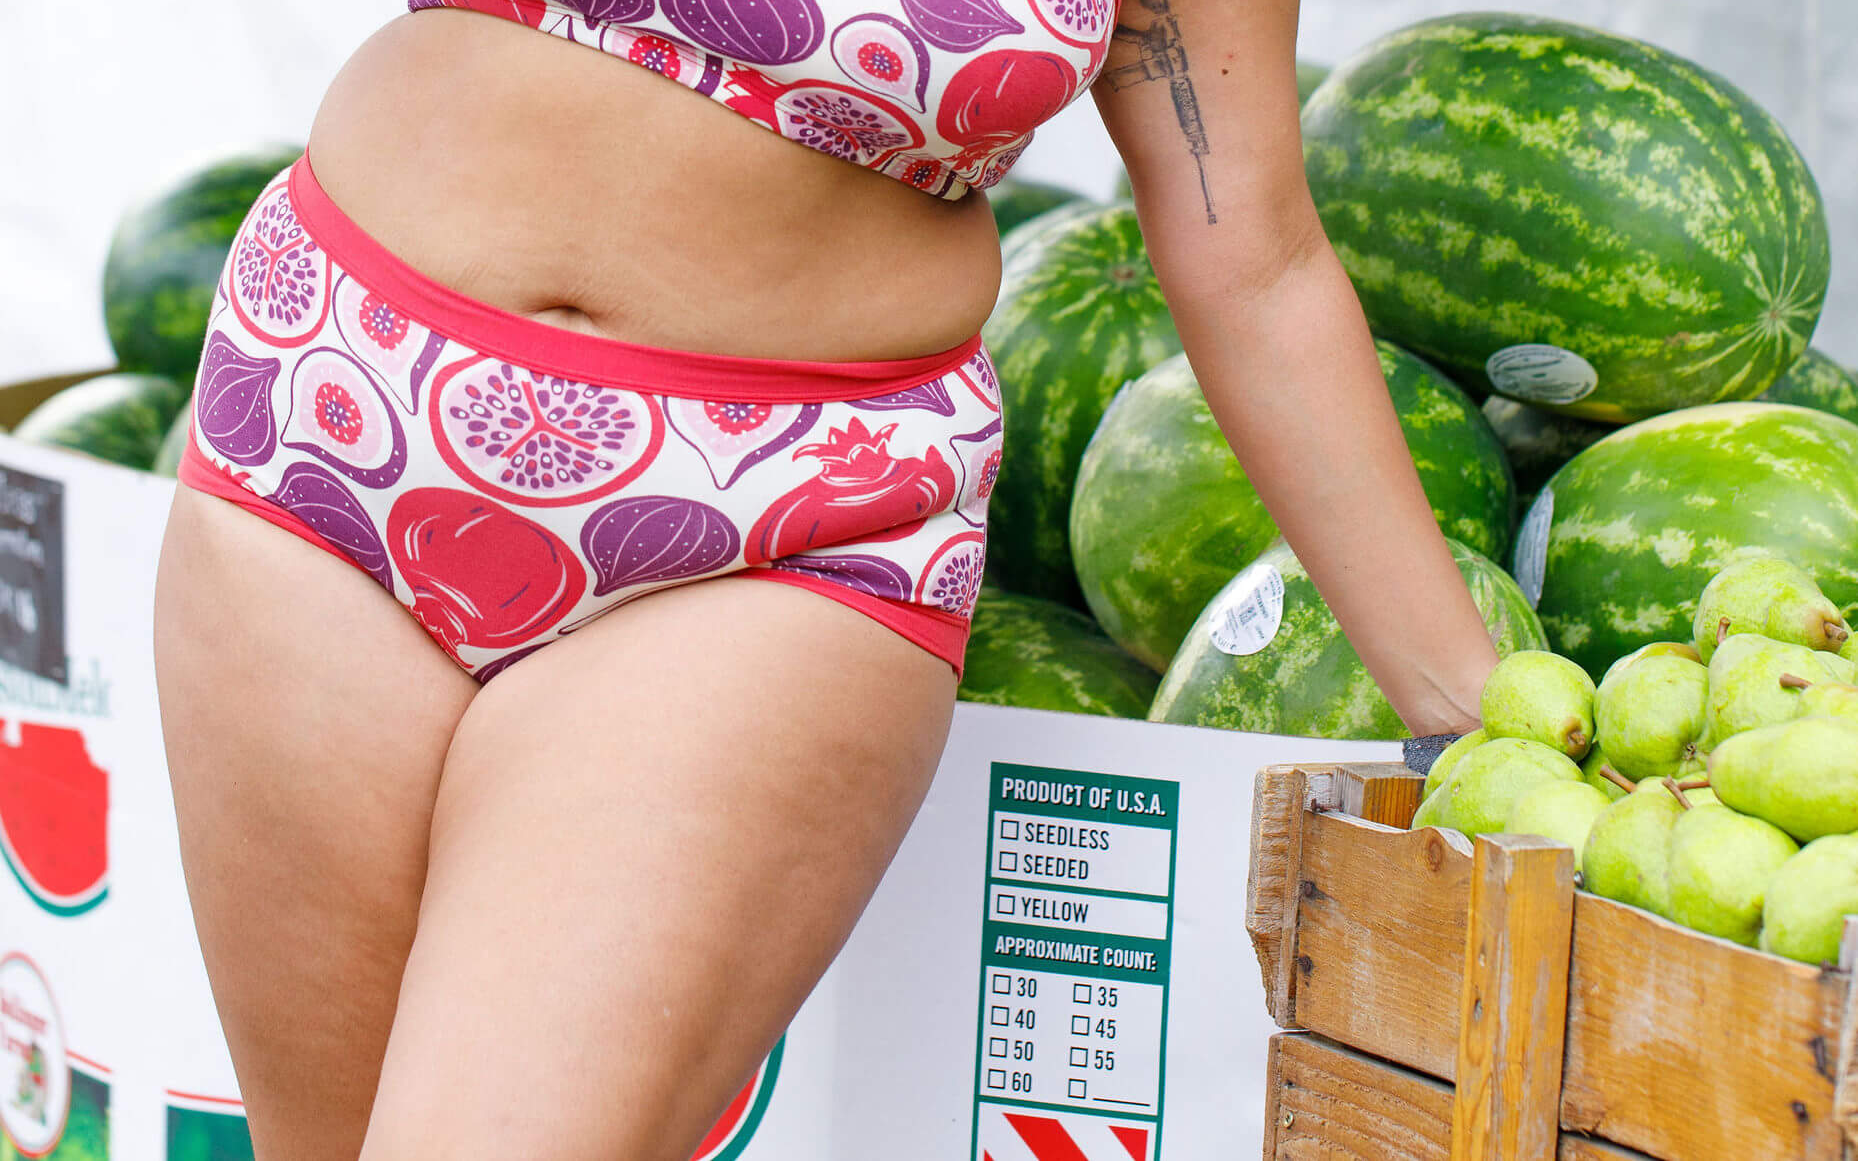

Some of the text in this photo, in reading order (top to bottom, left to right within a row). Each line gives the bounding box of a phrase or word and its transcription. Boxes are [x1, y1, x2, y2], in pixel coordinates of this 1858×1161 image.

[1002, 777, 1166, 815] PRODUCT OF U.S.A.
[1024, 822, 1110, 850] SEEDLESS
[1023, 854, 1089, 880] SEEDED
[1021, 896, 1089, 923] YELLOW
[995, 935, 1157, 971] APPROXIMATE COUNT:
[1016, 977, 1037, 998] 30
[1097, 986, 1118, 1007] 35
[1014, 1009, 1035, 1030] 40
[1095, 1018, 1117, 1039] 45
[1013, 1041, 1034, 1061] 50
[1094, 1050, 1115, 1071] 55
[1011, 1072, 1032, 1093] 60
